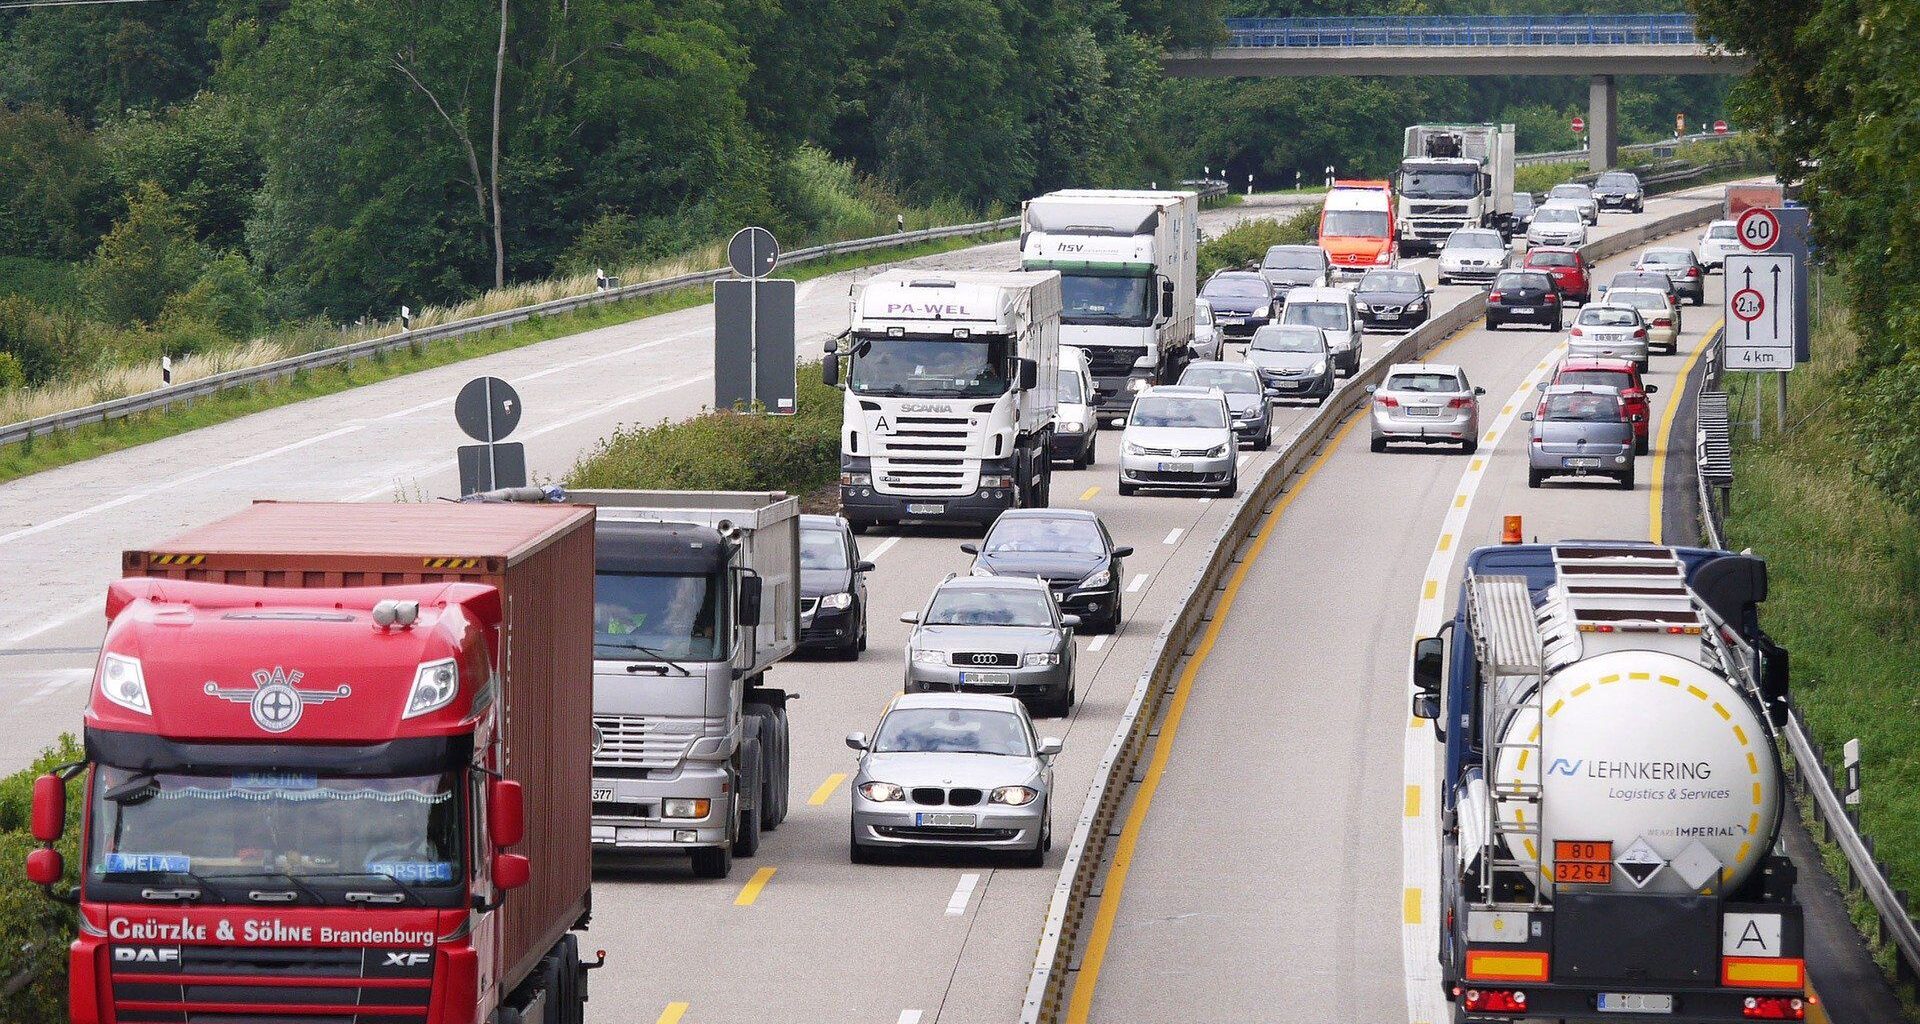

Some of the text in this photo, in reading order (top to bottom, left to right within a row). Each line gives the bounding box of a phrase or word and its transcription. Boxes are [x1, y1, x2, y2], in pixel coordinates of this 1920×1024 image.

[1746, 220, 1770, 239] 60
[1057, 242, 1084, 252] hsv
[887, 303, 971, 316] PA-WEL
[1743, 350, 1775, 363] 4 km
[901, 403, 953, 413] SCANIA
[874, 415, 890, 431] A
[251, 665, 305, 690] DAF
[1588, 759, 1712, 780] LEHNKERING
[1608, 787, 1730, 802] Logistics & Services
[1675, 826, 1735, 837] IMPERIAL
[1571, 843, 1595, 859] 80
[124, 855, 170, 872] MELA
[1558, 864, 1607, 879] 3264
[216, 919, 235, 941] &
[320, 928, 433, 946] Brandenburg
[1736, 920, 1767, 950] A
[115, 947, 178, 962] DAF
[382, 952, 430, 966] XF
